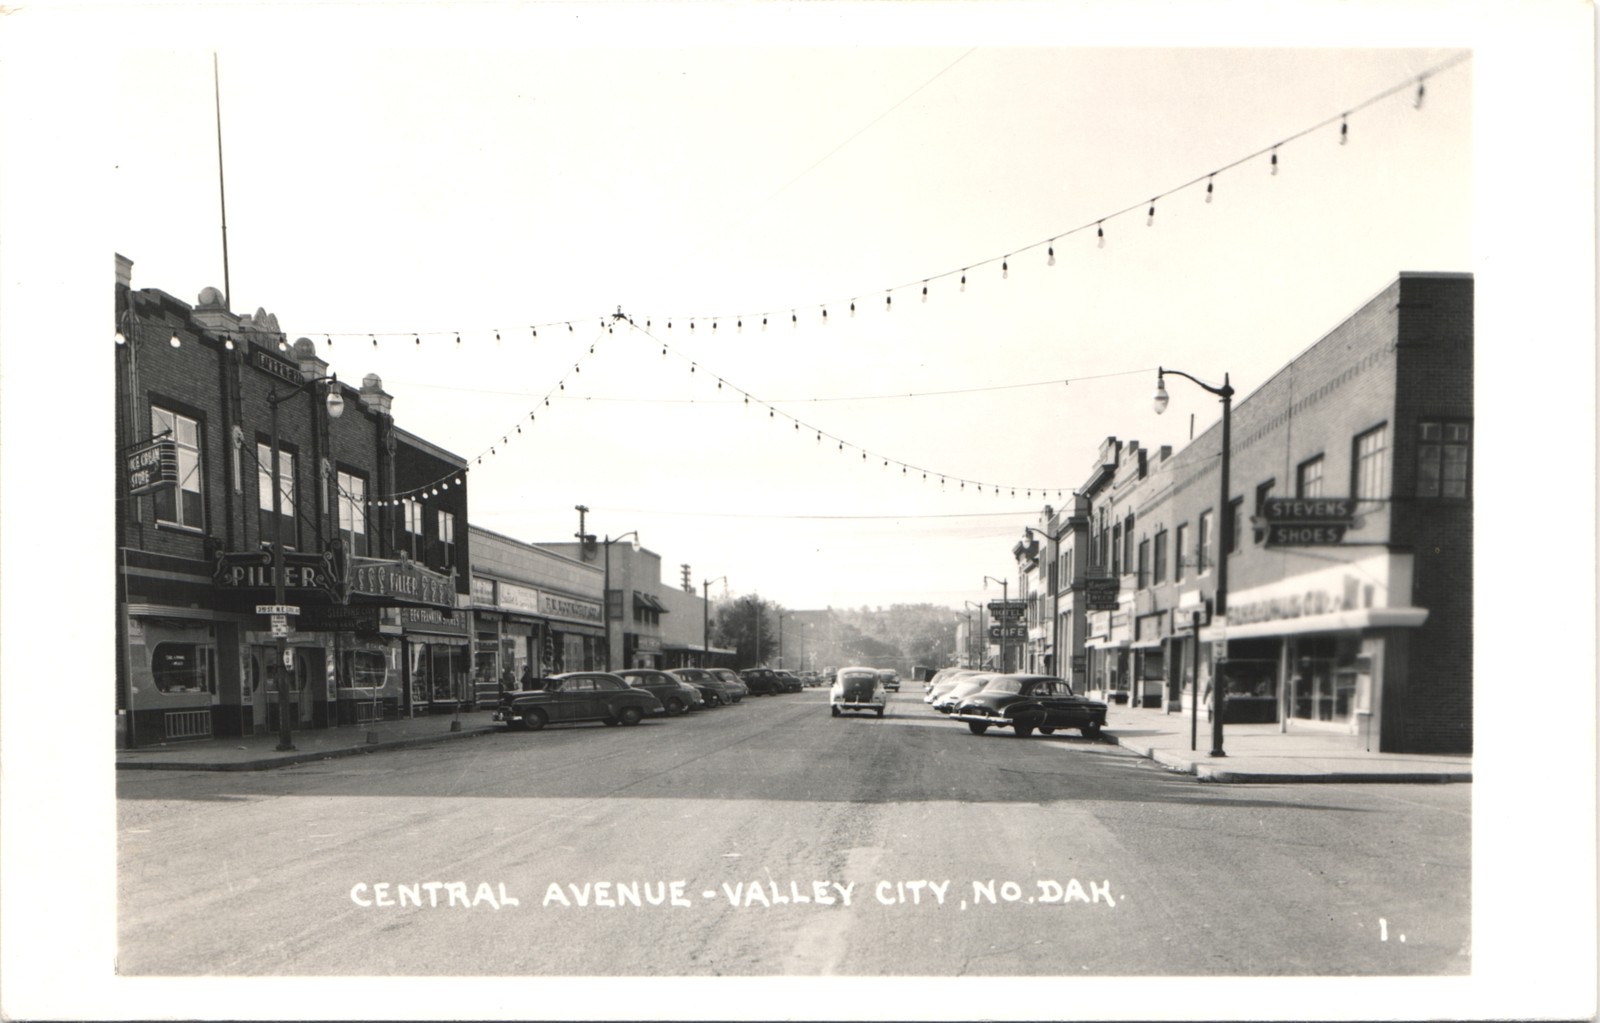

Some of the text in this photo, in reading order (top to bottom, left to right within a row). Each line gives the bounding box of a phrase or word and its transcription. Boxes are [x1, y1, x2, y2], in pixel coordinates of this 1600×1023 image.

[1272, 502, 1347, 516] STEVENS
[1277, 528, 1337, 542] SHOES
[992, 628, 1025, 637] CAFE
